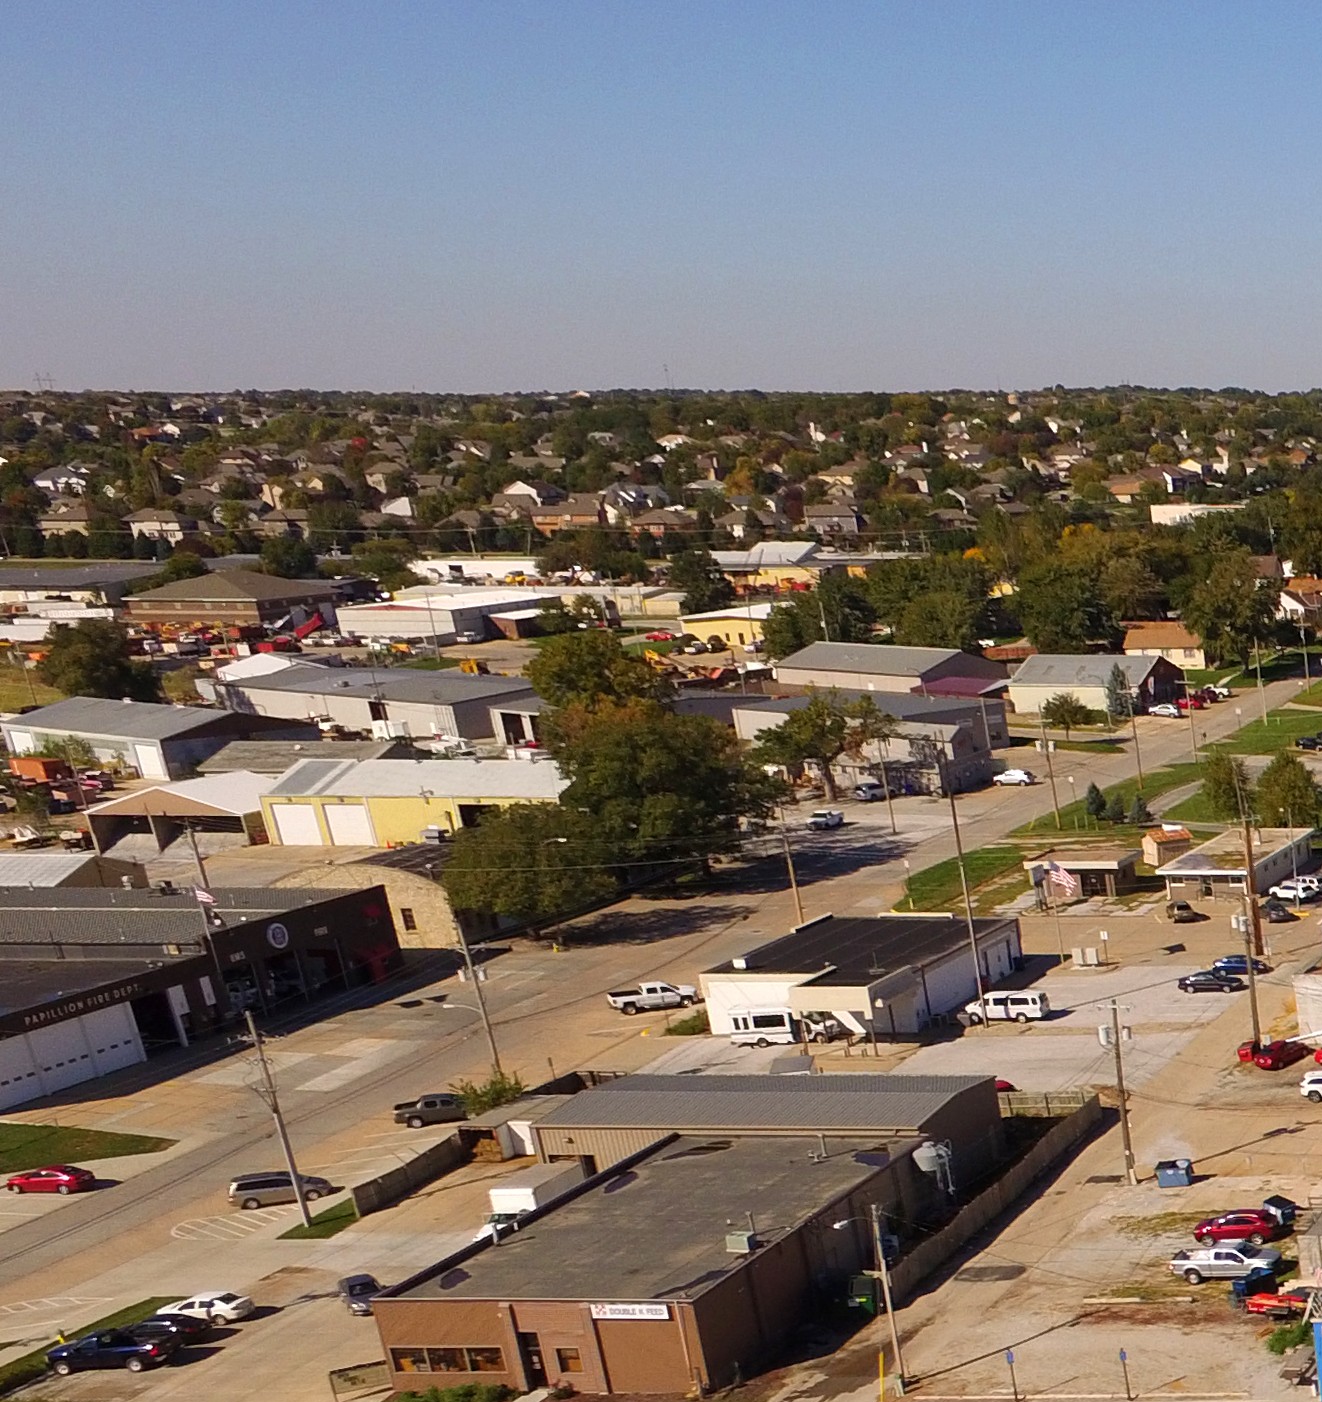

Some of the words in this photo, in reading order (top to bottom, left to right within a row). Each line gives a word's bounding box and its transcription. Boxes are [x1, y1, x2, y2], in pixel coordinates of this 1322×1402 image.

[24, 1002, 84, 1026] PAPILLION
[87, 991, 111, 1007] FIRE
[609, 1308, 637, 1316] DOUBLE
[646, 1308, 665, 1316] FEED
